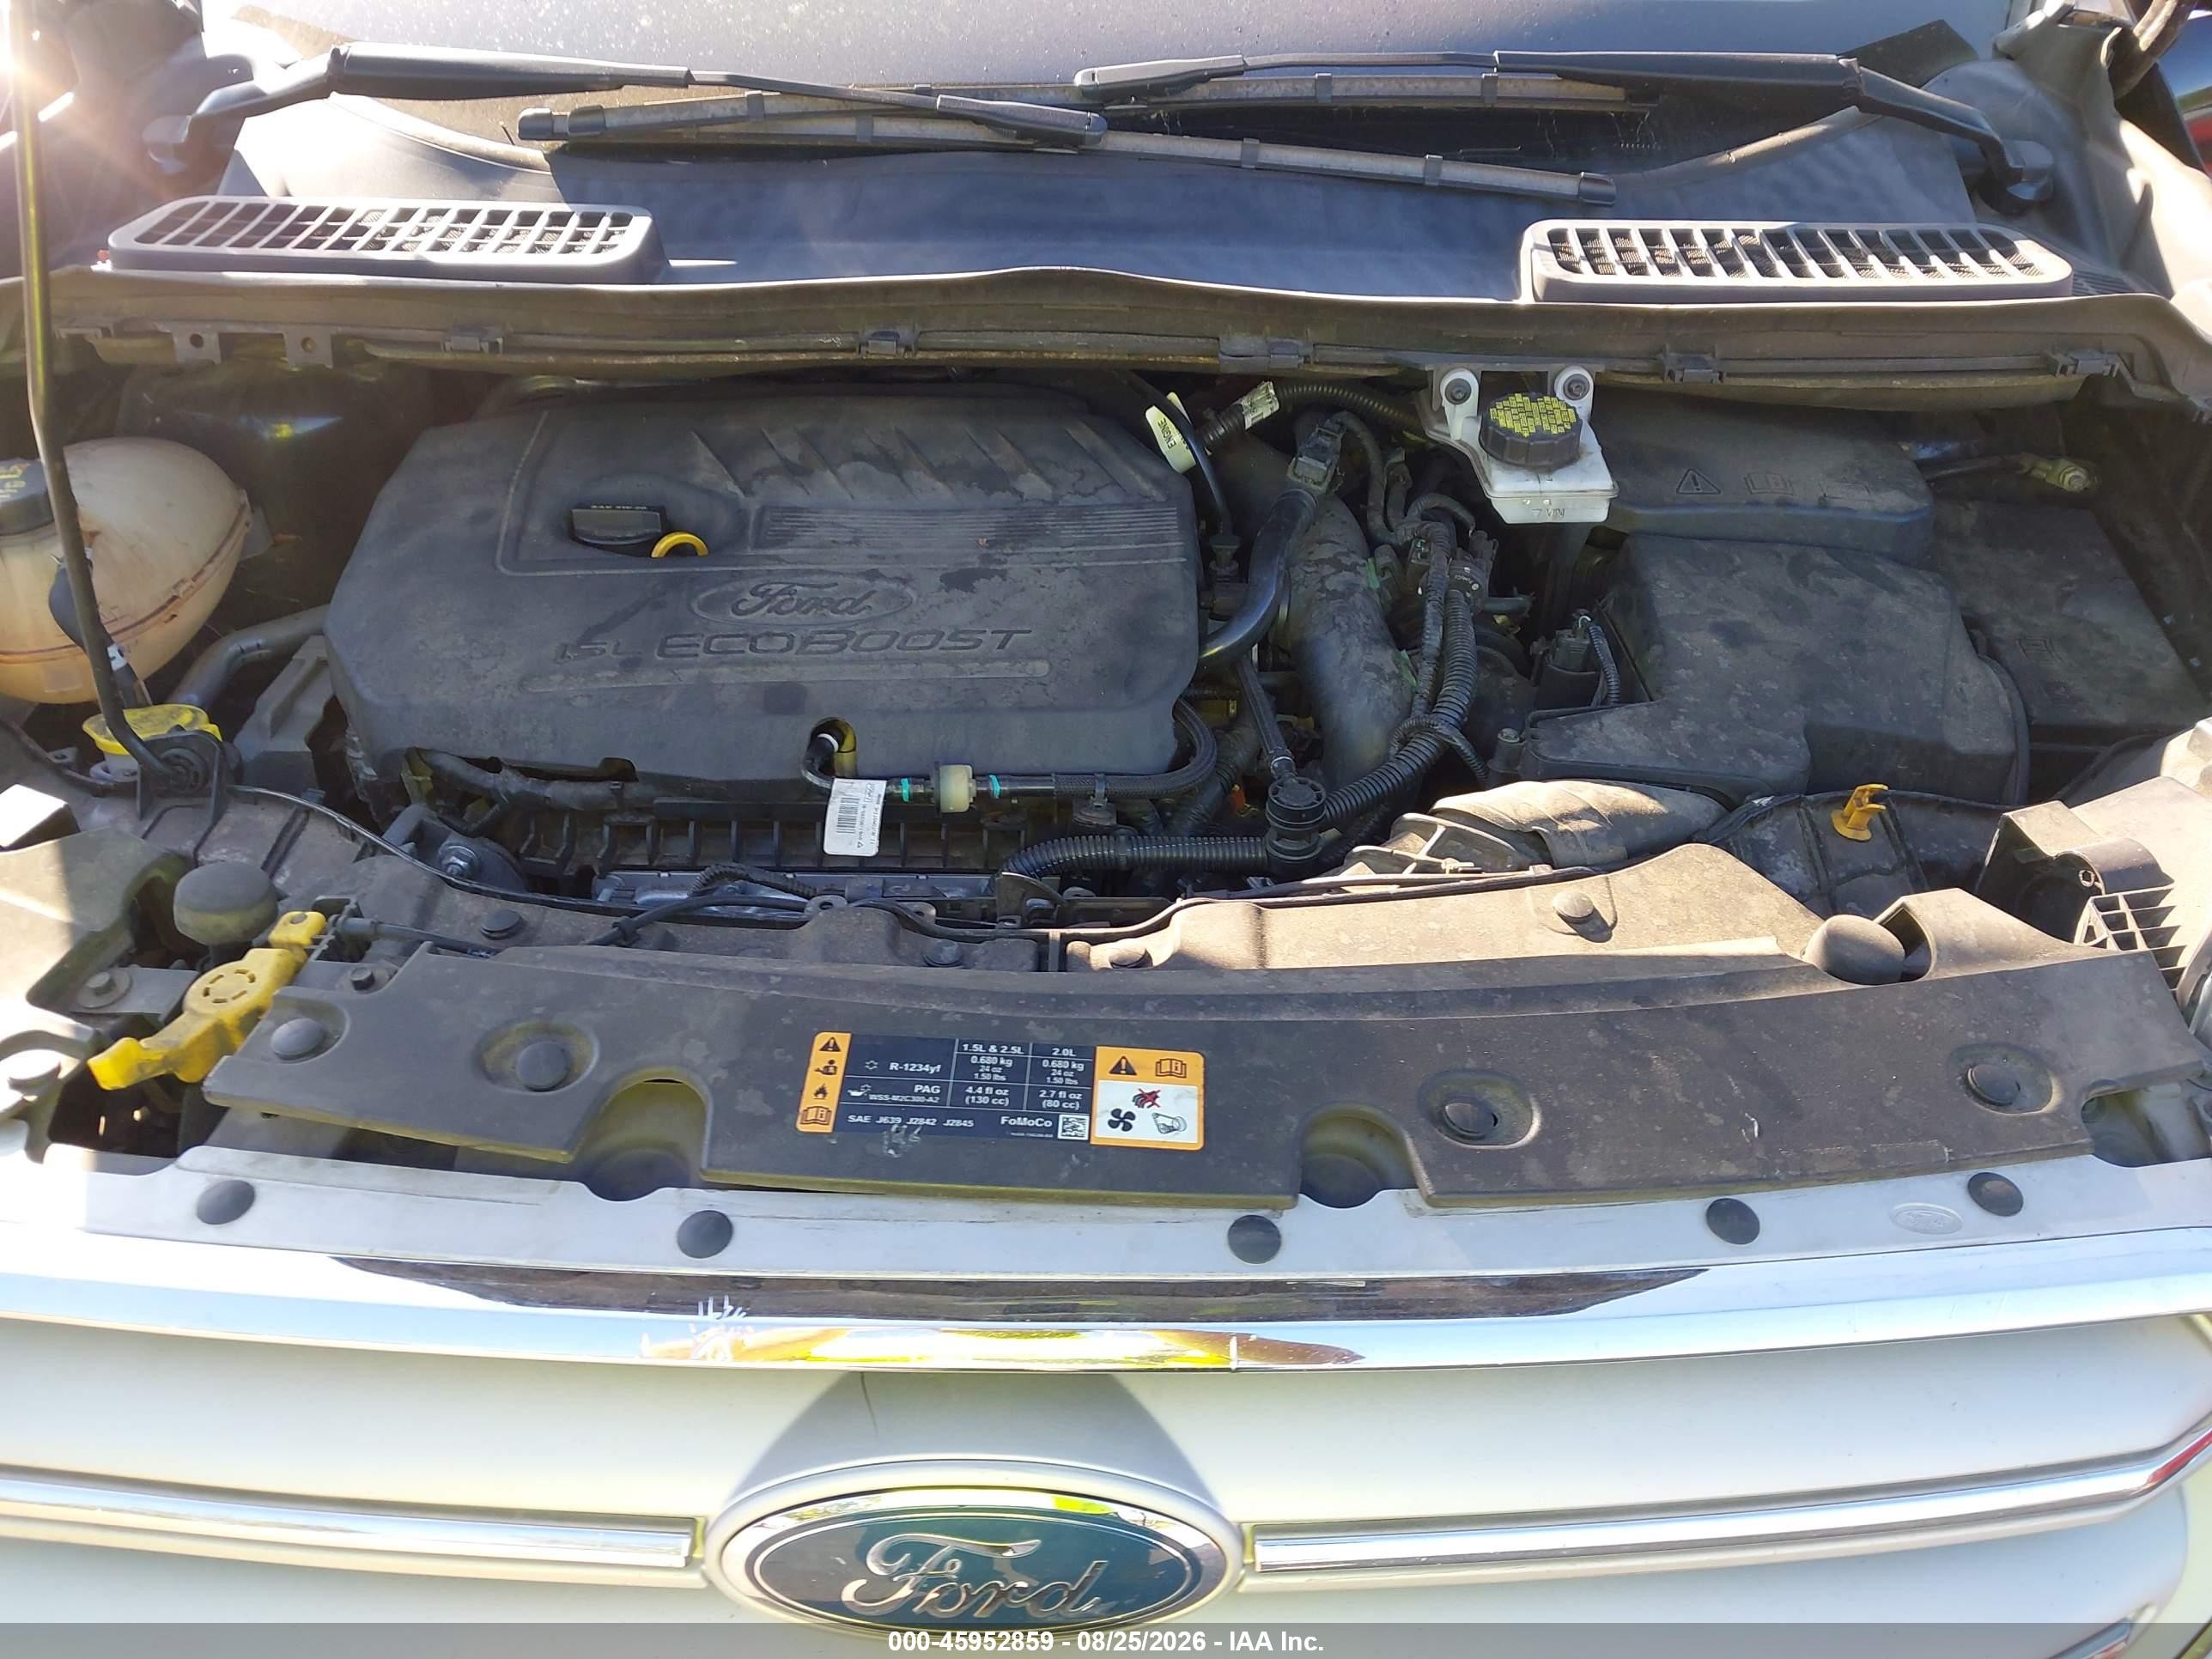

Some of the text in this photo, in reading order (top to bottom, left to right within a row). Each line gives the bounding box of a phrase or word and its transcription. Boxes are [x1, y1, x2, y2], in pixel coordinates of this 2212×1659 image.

[1157, 416, 1177, 449] ENGINE
[731, 580, 876, 617] Ford
[654, 629, 1032, 659] ECOBOOST
[962, 1043, 1024, 1054] 1.5L & 2.5L
[1052, 1048, 1077, 1057] 2.0L
[889, 1061, 942, 1074] R-1234yf
[1000, 1057, 1013, 1068] kg
[1071, 1061, 1085, 1072] kg
[914, 1084, 941, 1094] PAG
[964, 1085, 982, 1095] 4.4
[994, 1088, 1010, 1097] oz
[1038, 1090, 1057, 1098] 2.7
[964, 1095, 1010, 1107] (130 cc)
[1042, 1099, 1080, 1110] (80 cc)
[847, 1114, 872, 1123] SAE
[1000, 1115, 1054, 1128] FoMoCo
[841, 1532, 1108, 1620] Ford
